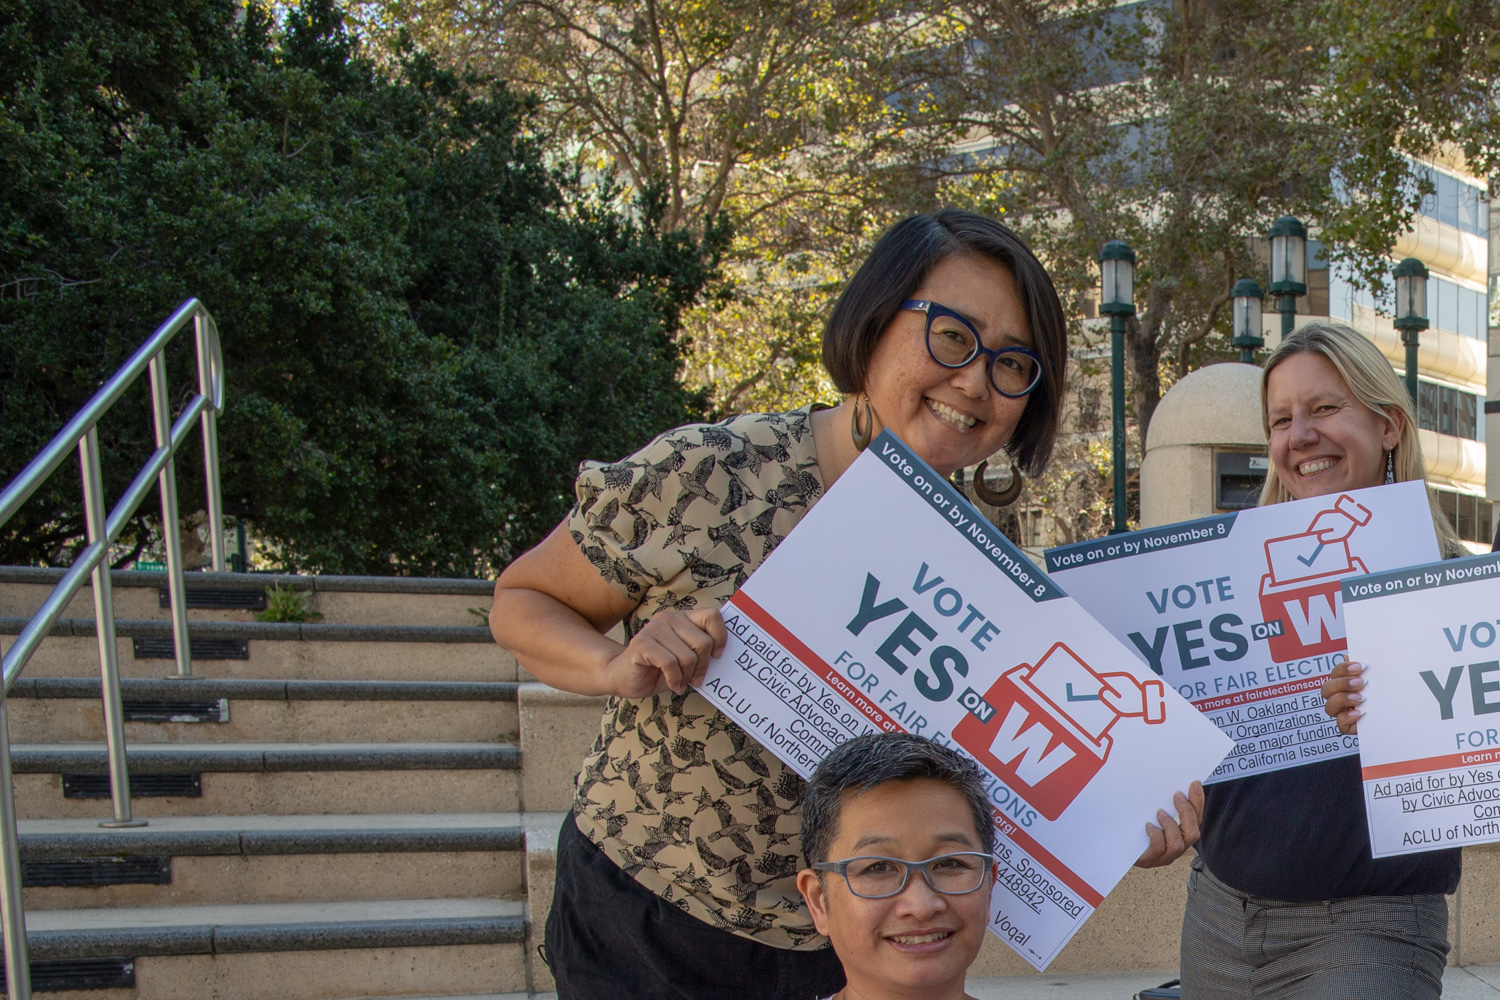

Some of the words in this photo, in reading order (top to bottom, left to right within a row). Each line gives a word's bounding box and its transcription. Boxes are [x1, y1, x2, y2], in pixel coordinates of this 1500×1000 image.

[881, 440, 914, 477] Vote
[912, 474, 933, 495] on
[932, 492, 951, 509] or
[947, 504, 969, 527] by
[965, 521, 1035, 587] November
[1032, 583, 1046, 597] 8
[1050, 552, 1084, 568] Vote
[1085, 548, 1105, 560] on
[1106, 544, 1121, 556] or
[1122, 540, 1141, 554] by
[1142, 526, 1214, 549] November
[1215, 522, 1226, 535] 8
[911, 560, 1002, 653] VOTE
[1144, 574, 1235, 615] VOTE
[1348, 582, 1382, 597] Vote
[1384, 578, 1403, 591] on
[1405, 575, 1421, 587] or
[1423, 571, 1443, 586] by
[1126, 612, 1249, 678] YES
[1254, 620, 1281, 638] ON
[1282, 589, 1346, 647] W
[832, 649, 880, 694] FOR
[877, 688, 928, 736] FAIR
[844, 570, 970, 703] YES
[962, 692, 993, 721] ON
[987, 700, 1077, 788] W
[1171, 680, 1208, 700] OR
[1212, 670, 1259, 694] FAIR
[1264, 652, 1347, 683] ELECTIO
[824, 670, 856, 700] Learn
[853, 696, 883, 723] more
[881, 720, 896, 734] at
[1203, 696, 1232, 709] more
[1232, 693, 1245, 704] at
[1454, 727, 1499, 750] FOR
[1460, 751, 1493, 764] Learn
[993, 909, 1032, 947] Voqal
